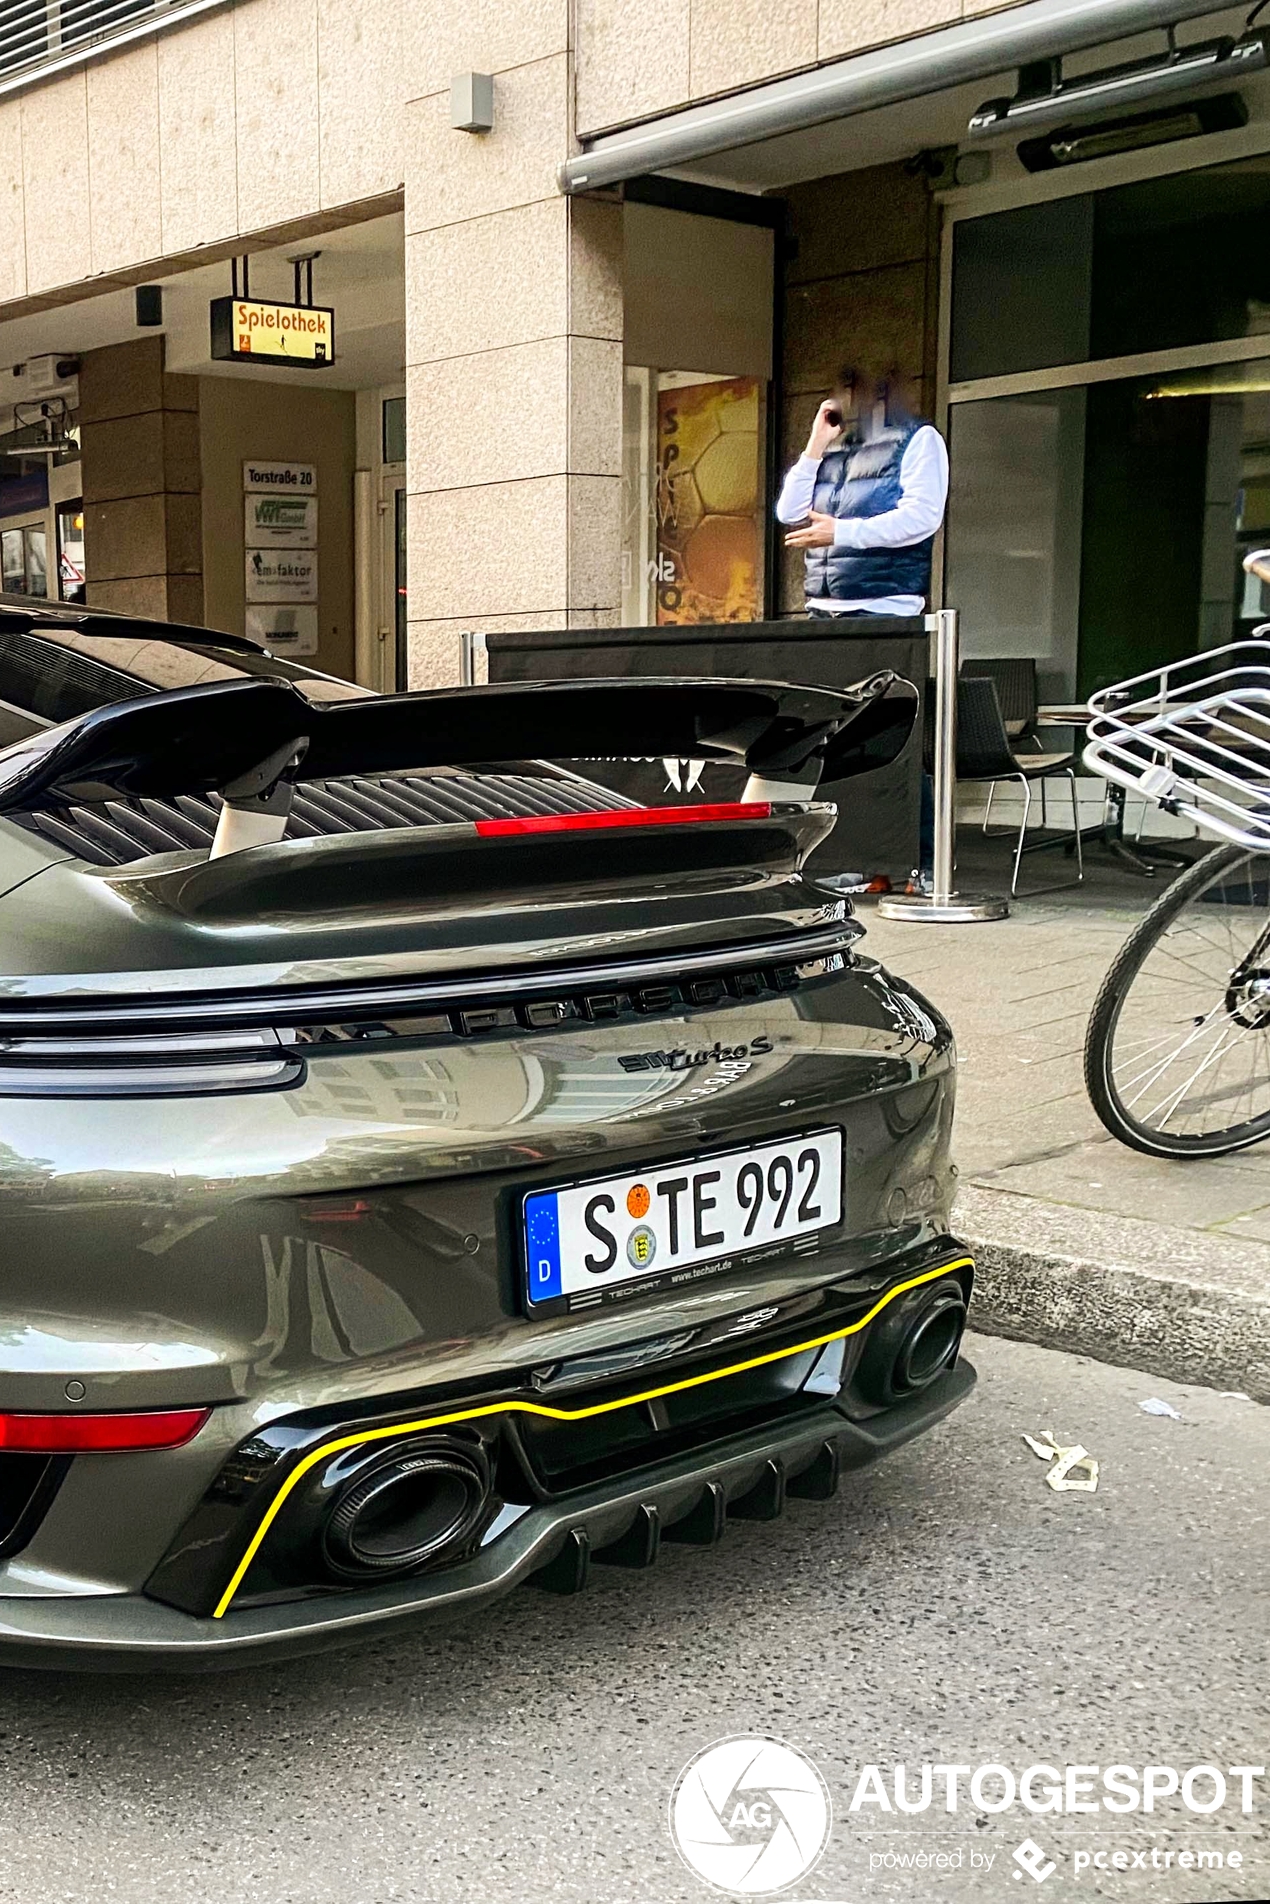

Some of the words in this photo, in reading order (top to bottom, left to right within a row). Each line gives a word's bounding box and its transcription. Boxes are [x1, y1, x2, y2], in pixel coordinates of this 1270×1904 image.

[238, 304, 326, 334] Spielothek
[248, 468, 298, 485] Torstraße
[300, 472, 312, 485] 20
[460, 967, 800, 1037] PORSCHE
[750, 1035, 774, 1056] S
[584, 1193, 619, 1275] S
[657, 1170, 726, 1256] TE
[736, 1148, 822, 1238] 992
[538, 1258, 551, 1283] D
[608, 1279, 662, 1299] TECHART
[671, 1260, 733, 1284] www.techart.de
[741, 1246, 786, 1265] TECHART
